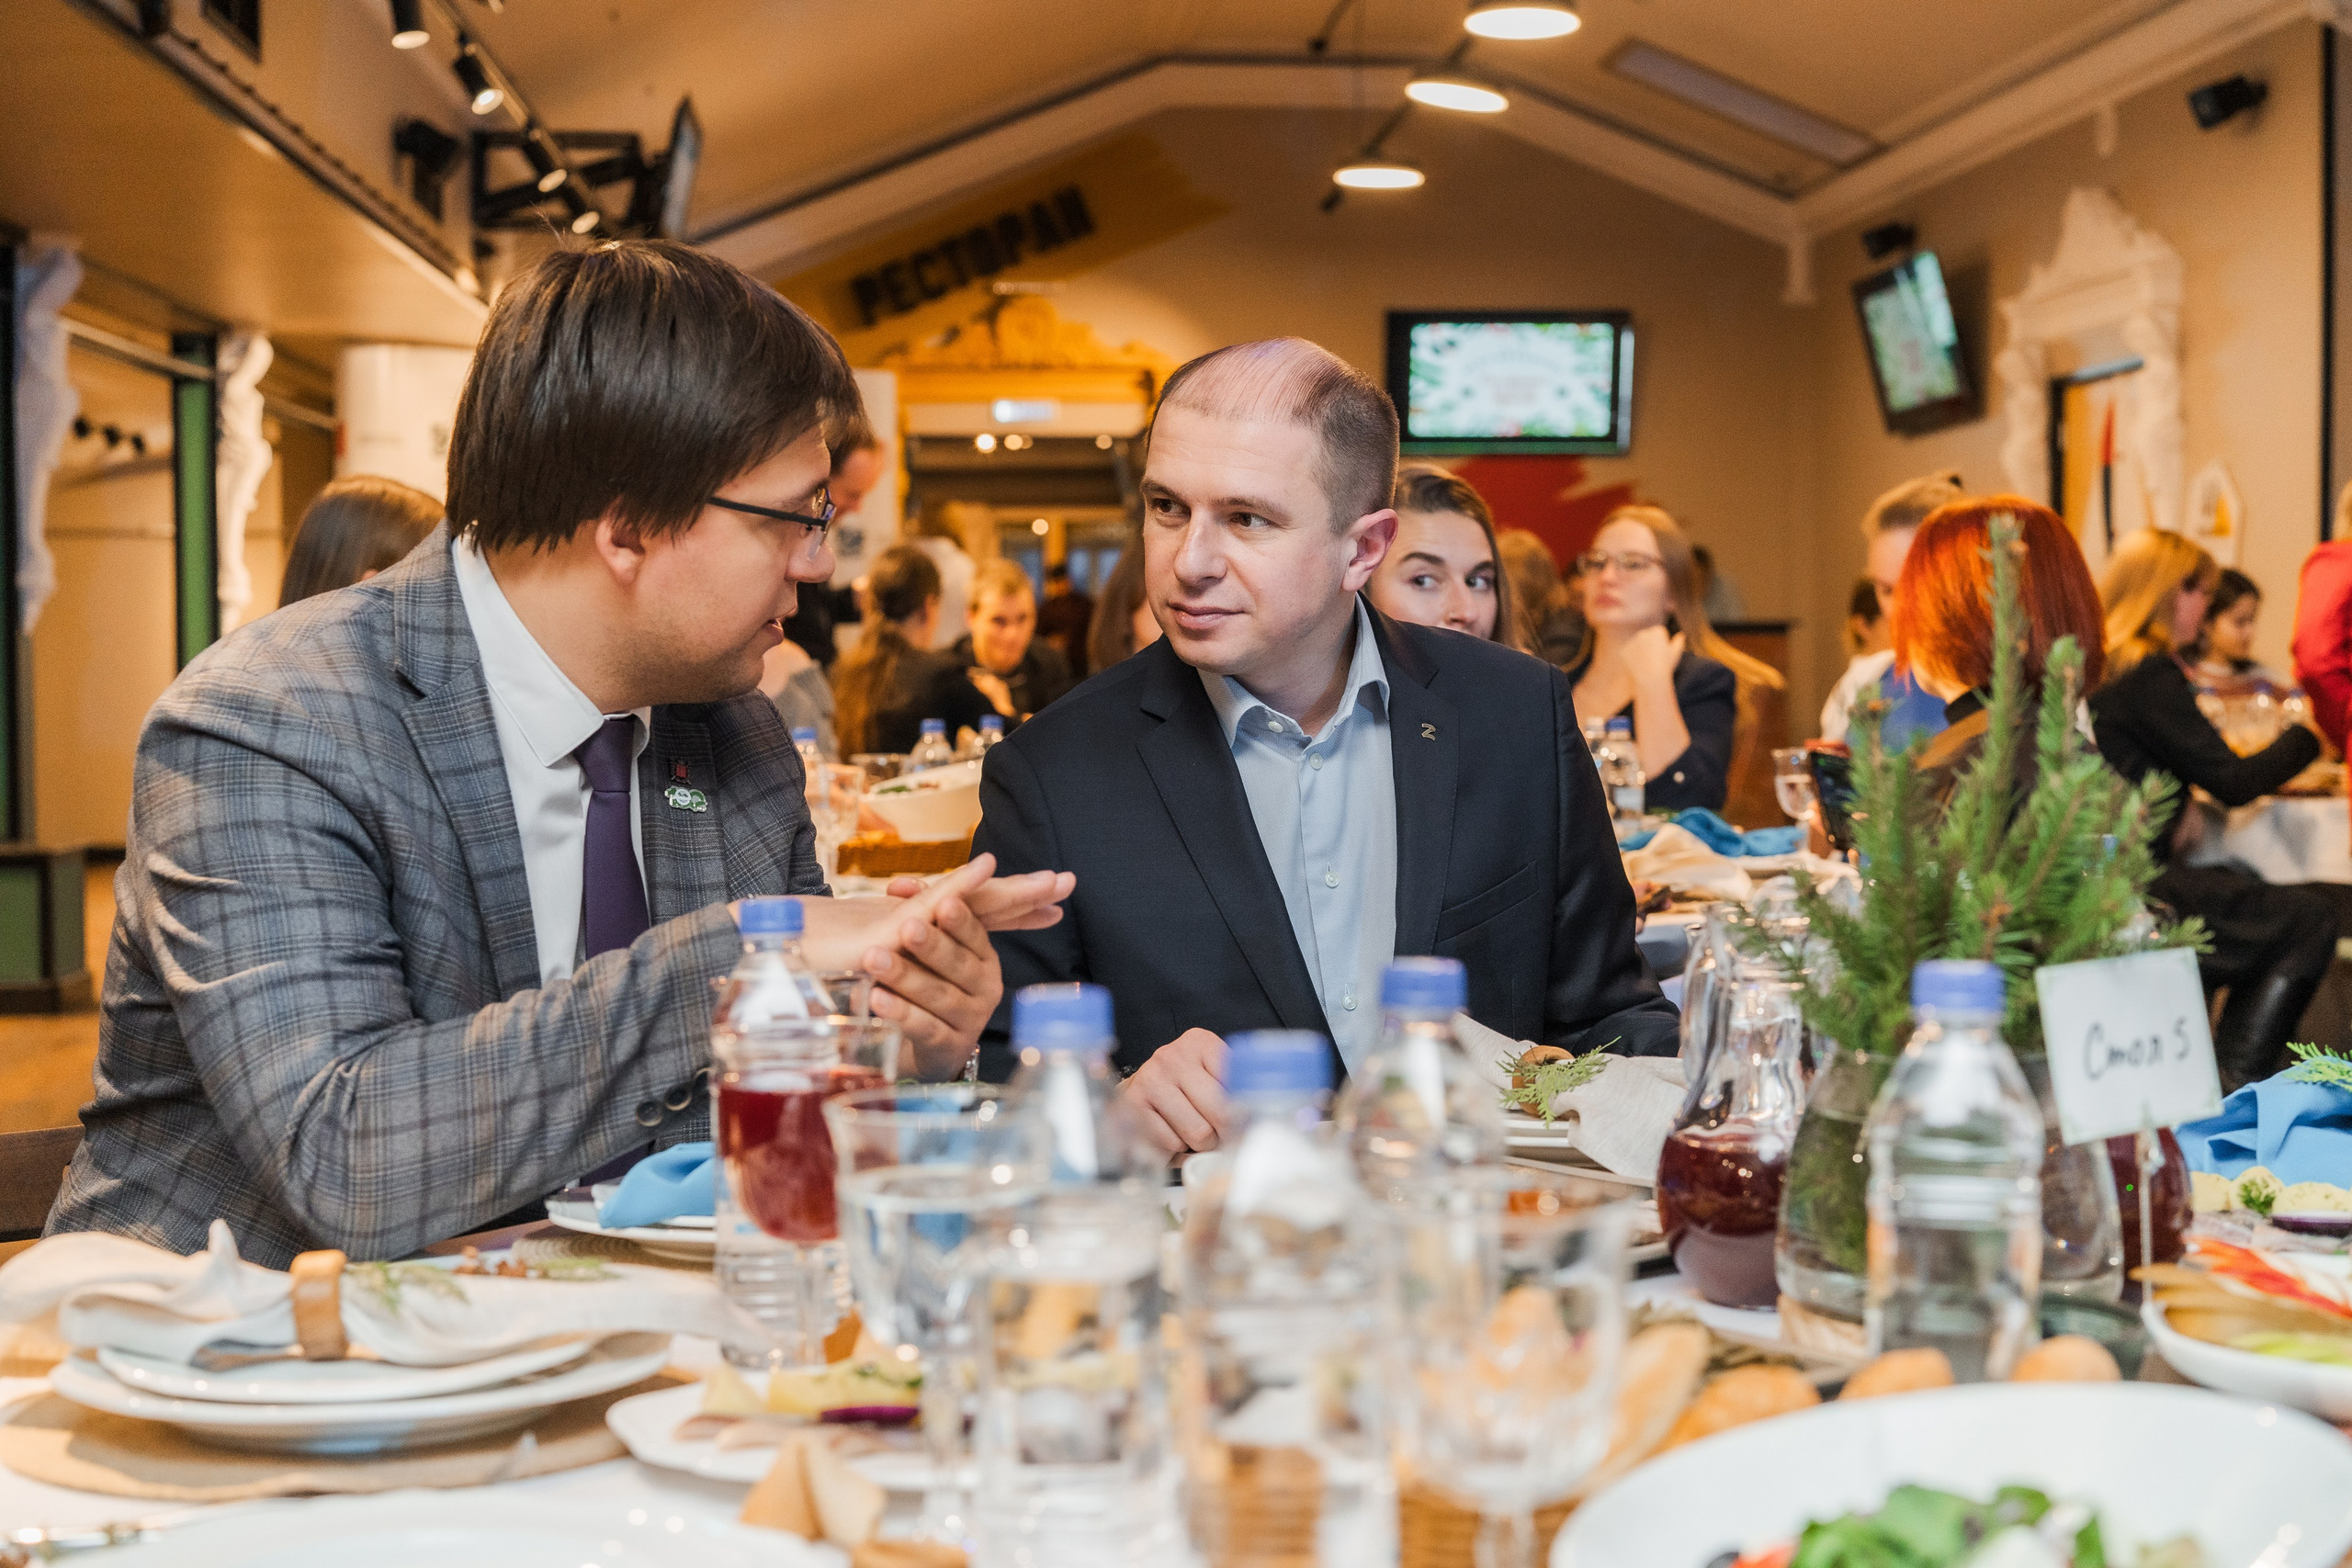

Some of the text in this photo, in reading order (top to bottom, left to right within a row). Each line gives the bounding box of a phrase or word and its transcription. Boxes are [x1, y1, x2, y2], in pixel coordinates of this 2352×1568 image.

[851, 186, 1094, 327] РЕСТОРАН
[1421, 723, 1437, 741] Z
[2172, 1014, 2192, 1062] 5
